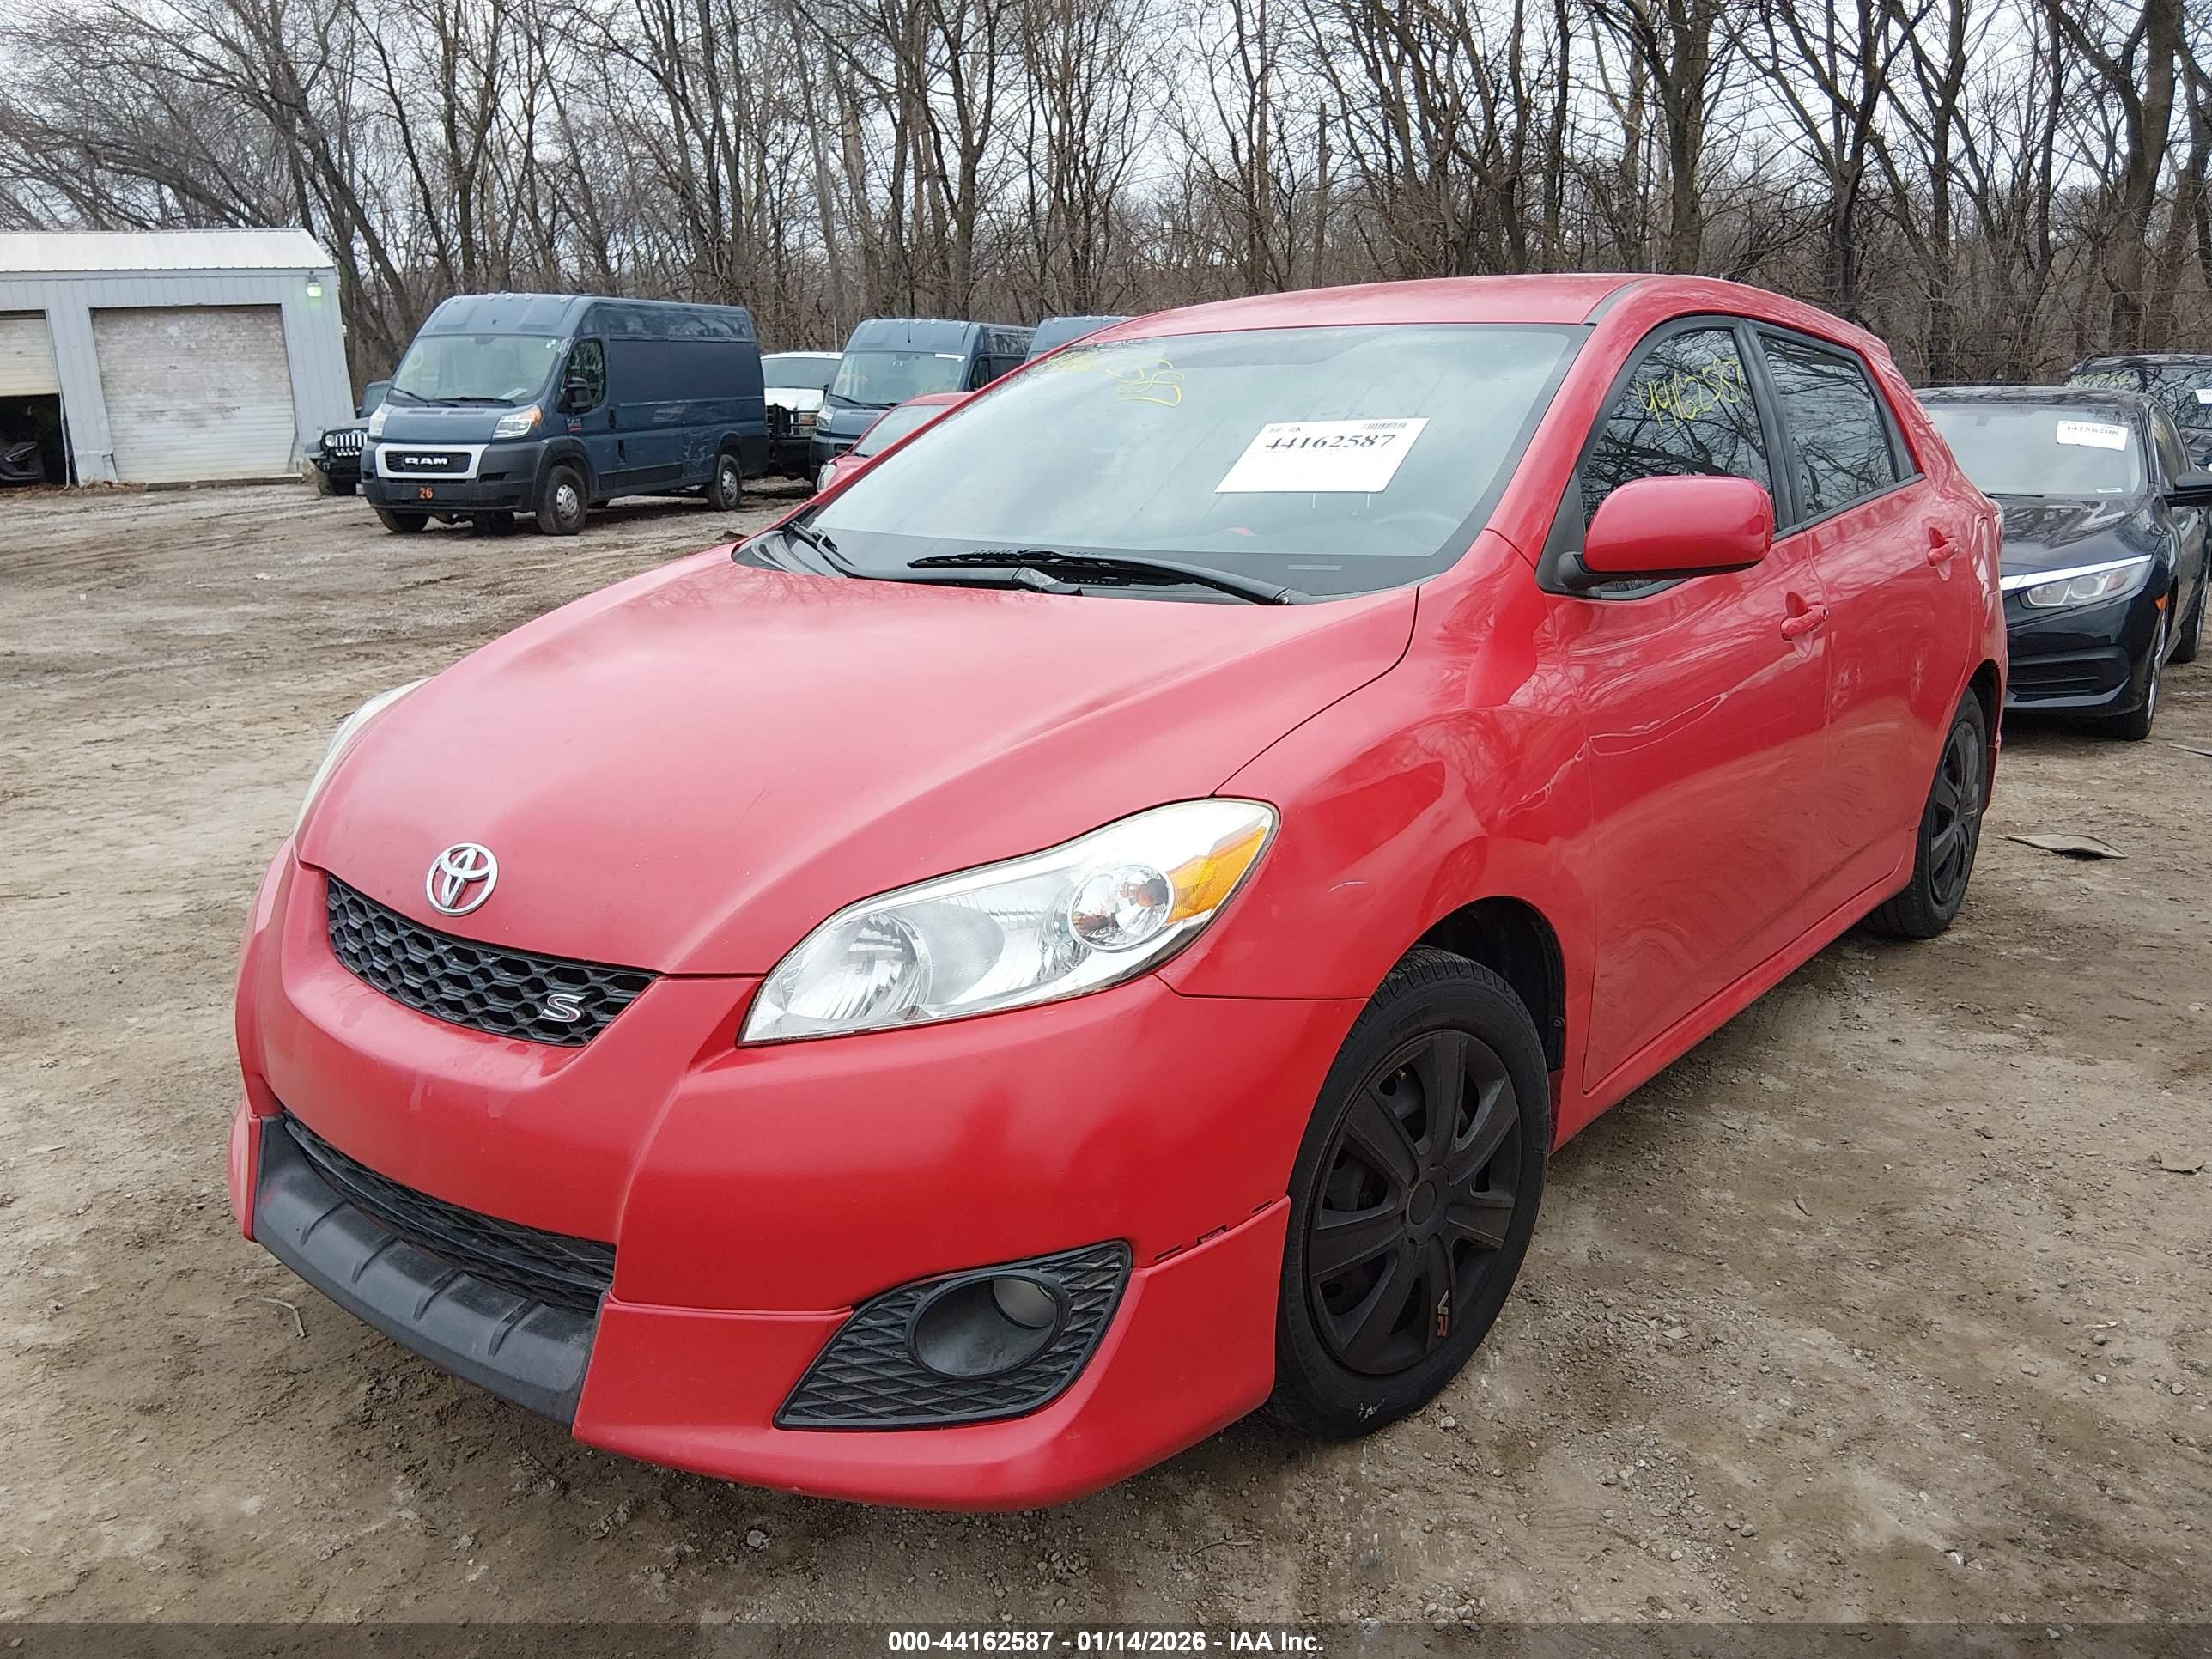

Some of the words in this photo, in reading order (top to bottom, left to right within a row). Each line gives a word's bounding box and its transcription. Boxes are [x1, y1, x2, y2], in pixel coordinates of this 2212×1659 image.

[1264, 434, 1398, 451] 44162587
[404, 456, 449, 466] RAM
[418, 486, 434, 500] 26
[541, 993, 587, 1024] S
